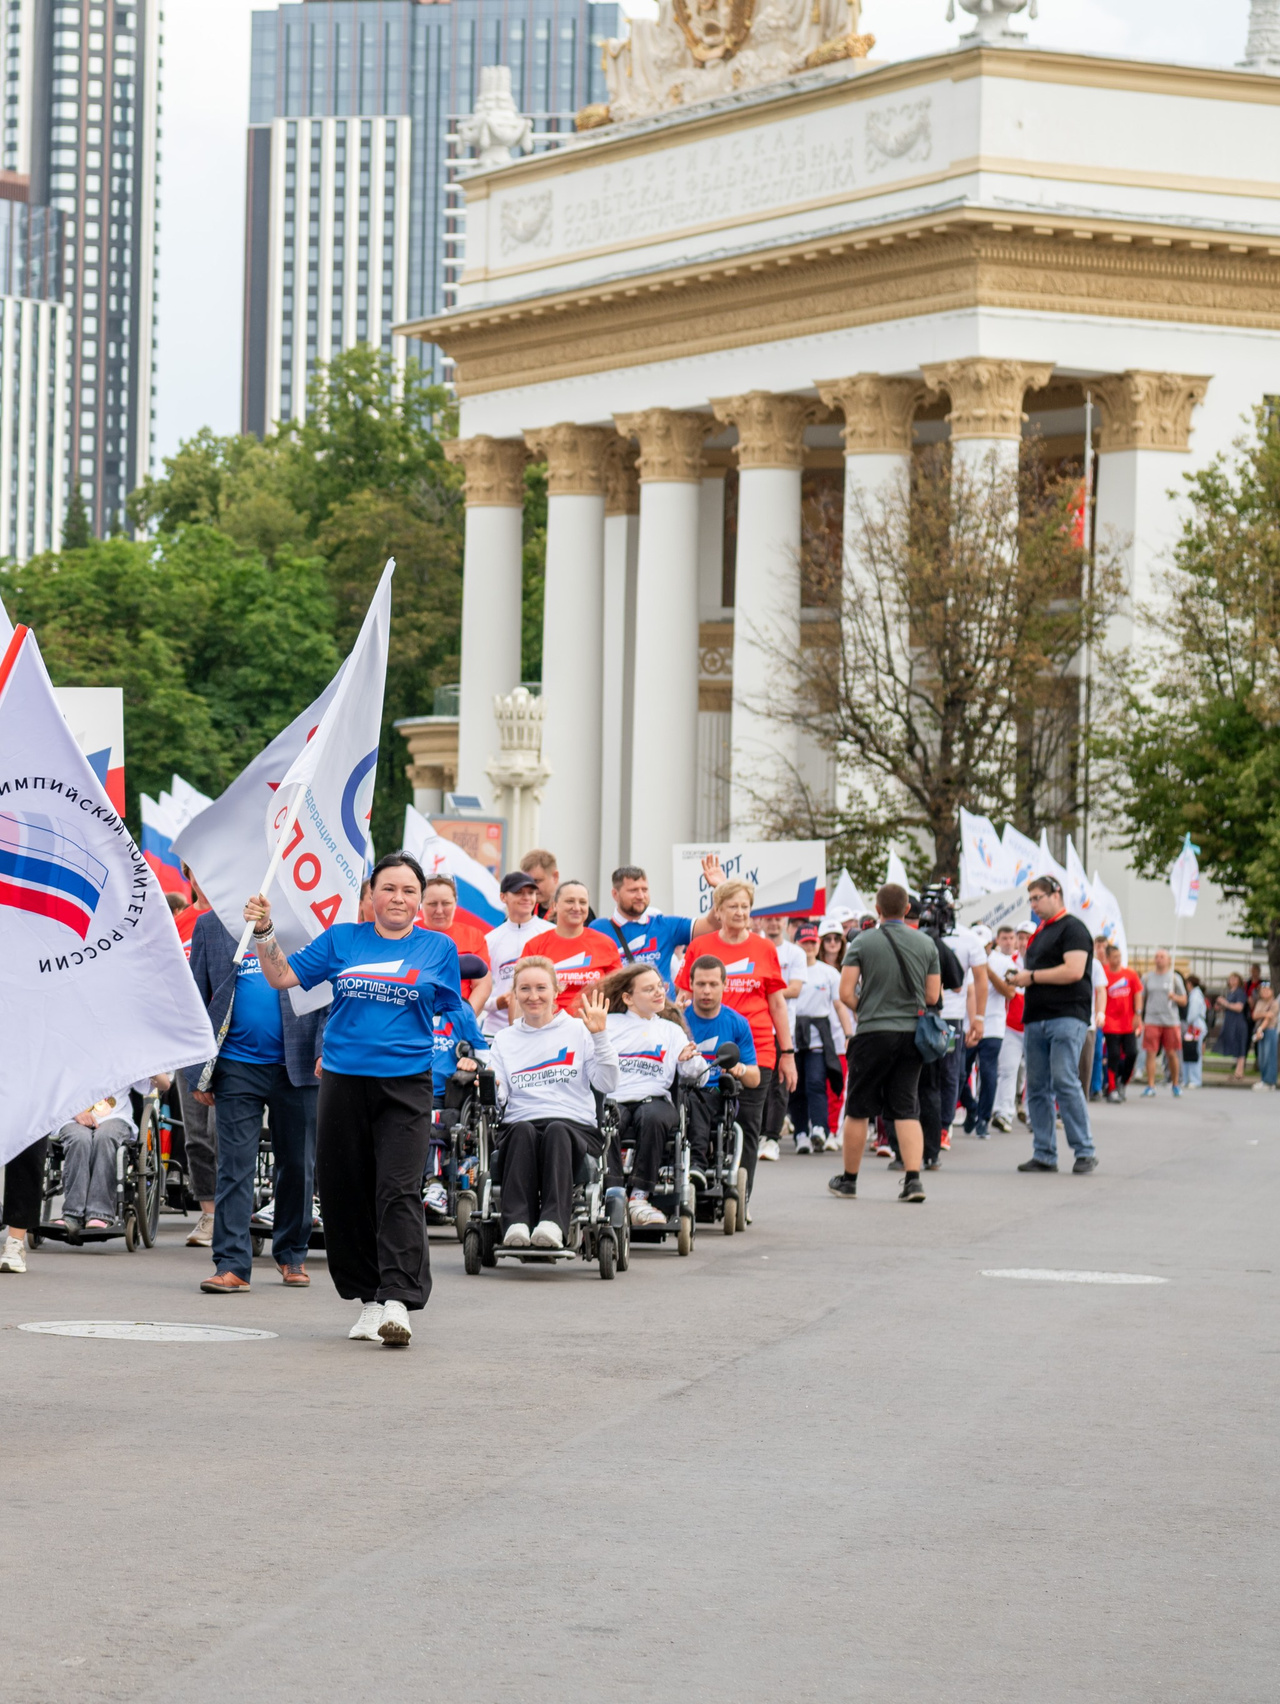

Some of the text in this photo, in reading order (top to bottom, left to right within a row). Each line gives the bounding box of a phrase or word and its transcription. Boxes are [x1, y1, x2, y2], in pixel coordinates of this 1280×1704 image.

[304, 787, 360, 898] едерация спорт
[38, 929, 124, 973] РОССИИ
[518, 1077, 570, 1089] ШЕСТВИЕ
